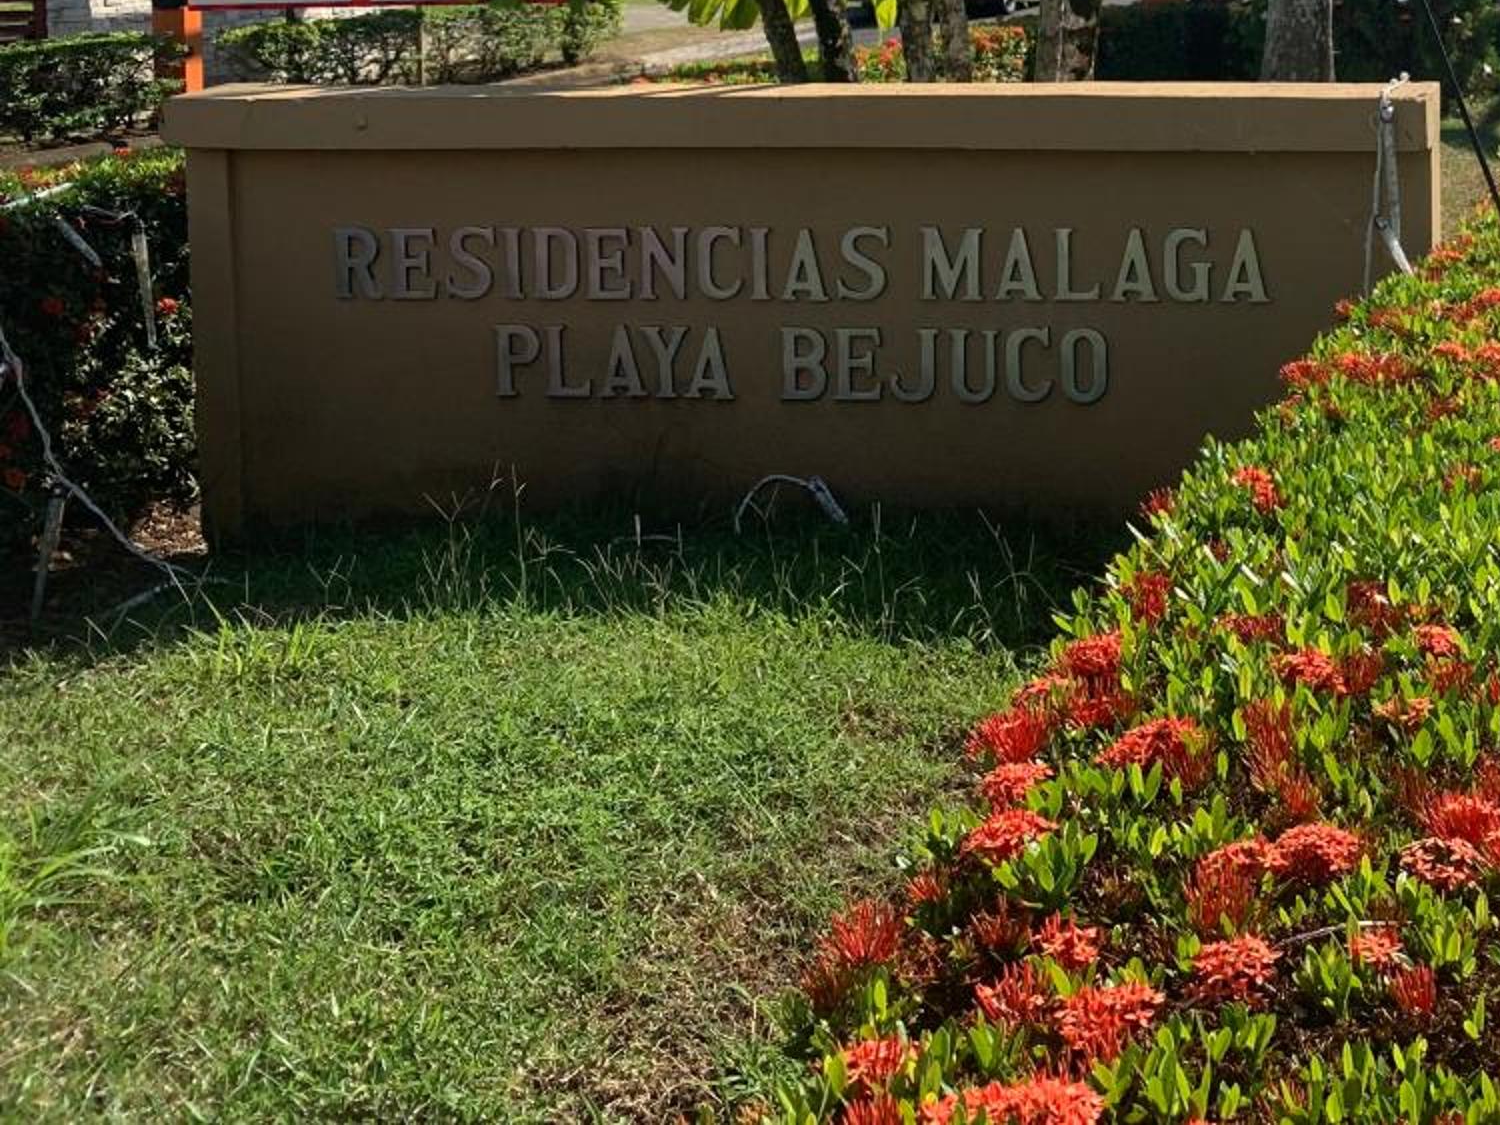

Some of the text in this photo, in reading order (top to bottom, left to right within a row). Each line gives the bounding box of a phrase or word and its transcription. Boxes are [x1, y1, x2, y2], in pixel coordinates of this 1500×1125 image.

[333, 226, 1270, 304] RESIDENCIAS MALAGA
[494, 325, 1109, 403] PLAYA BEJUCO
